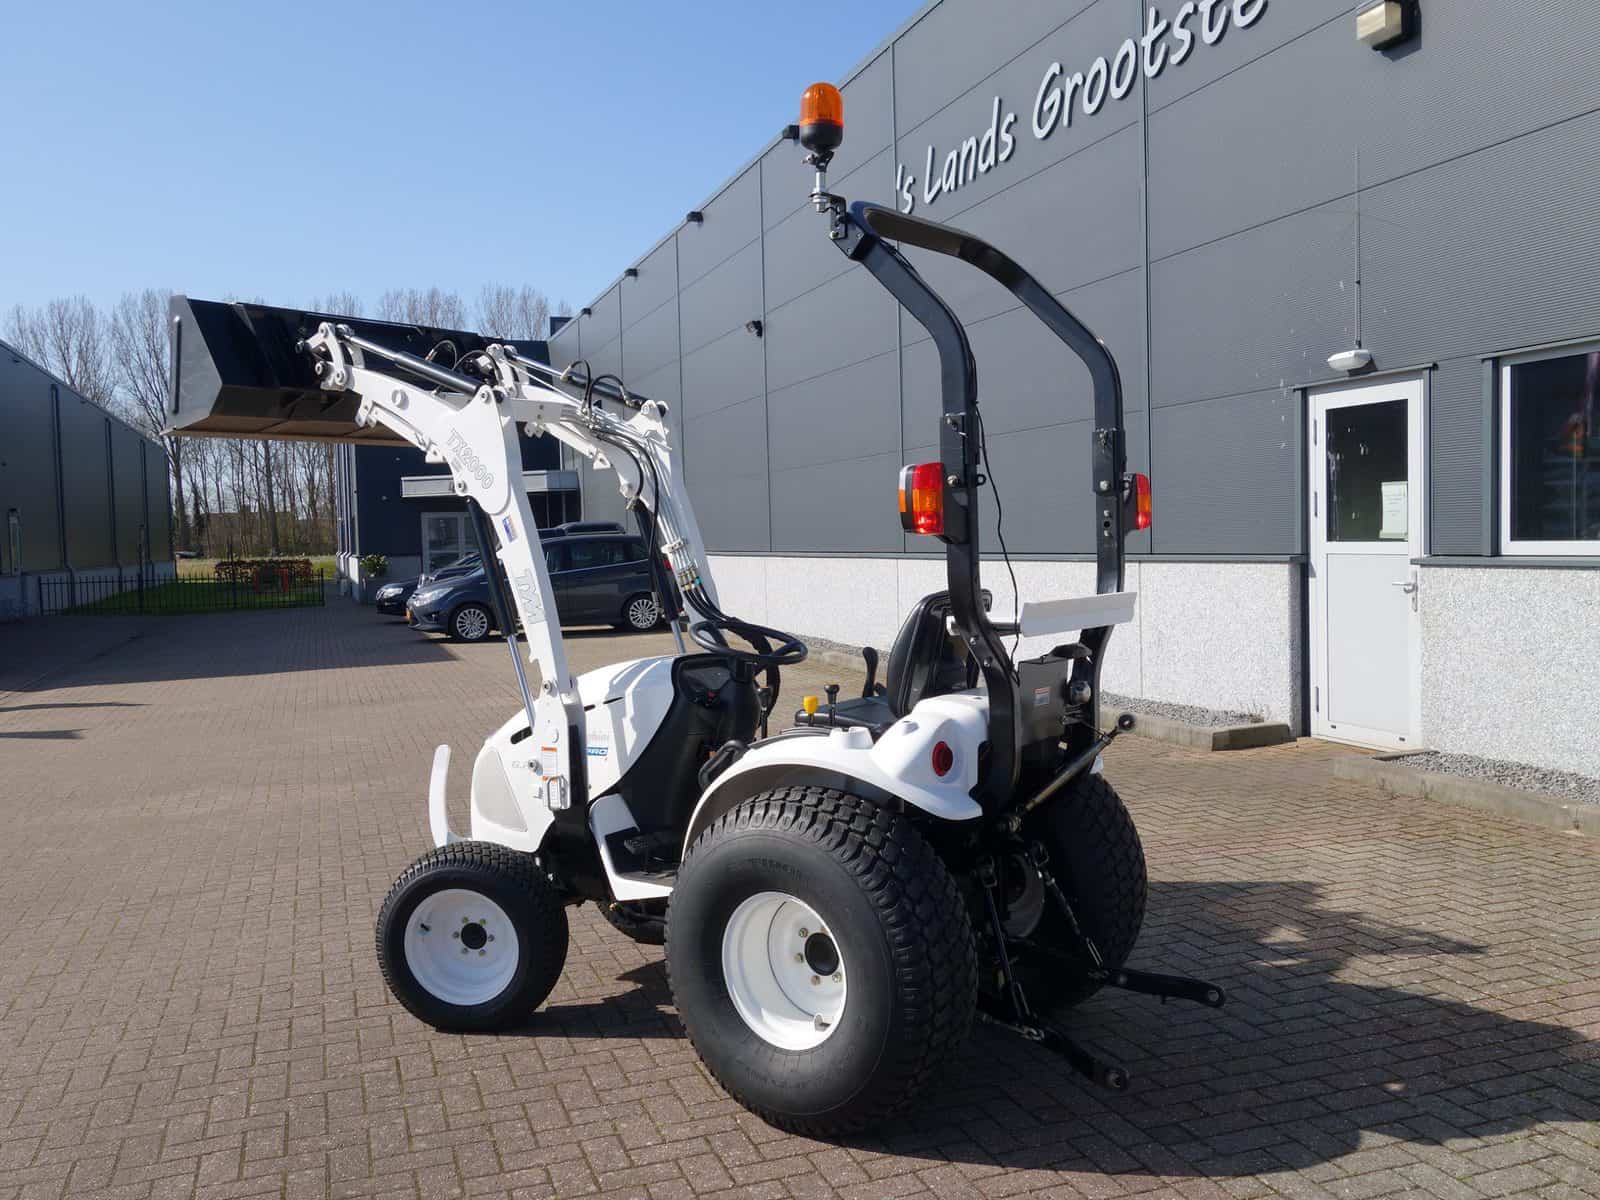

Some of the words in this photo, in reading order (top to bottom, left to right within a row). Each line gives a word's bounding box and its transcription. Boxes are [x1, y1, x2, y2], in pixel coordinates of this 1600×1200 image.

[924, 96, 1015, 203] Lands
[1032, 0, 1265, 139] Grootste
[447, 428, 495, 489] TX2000
